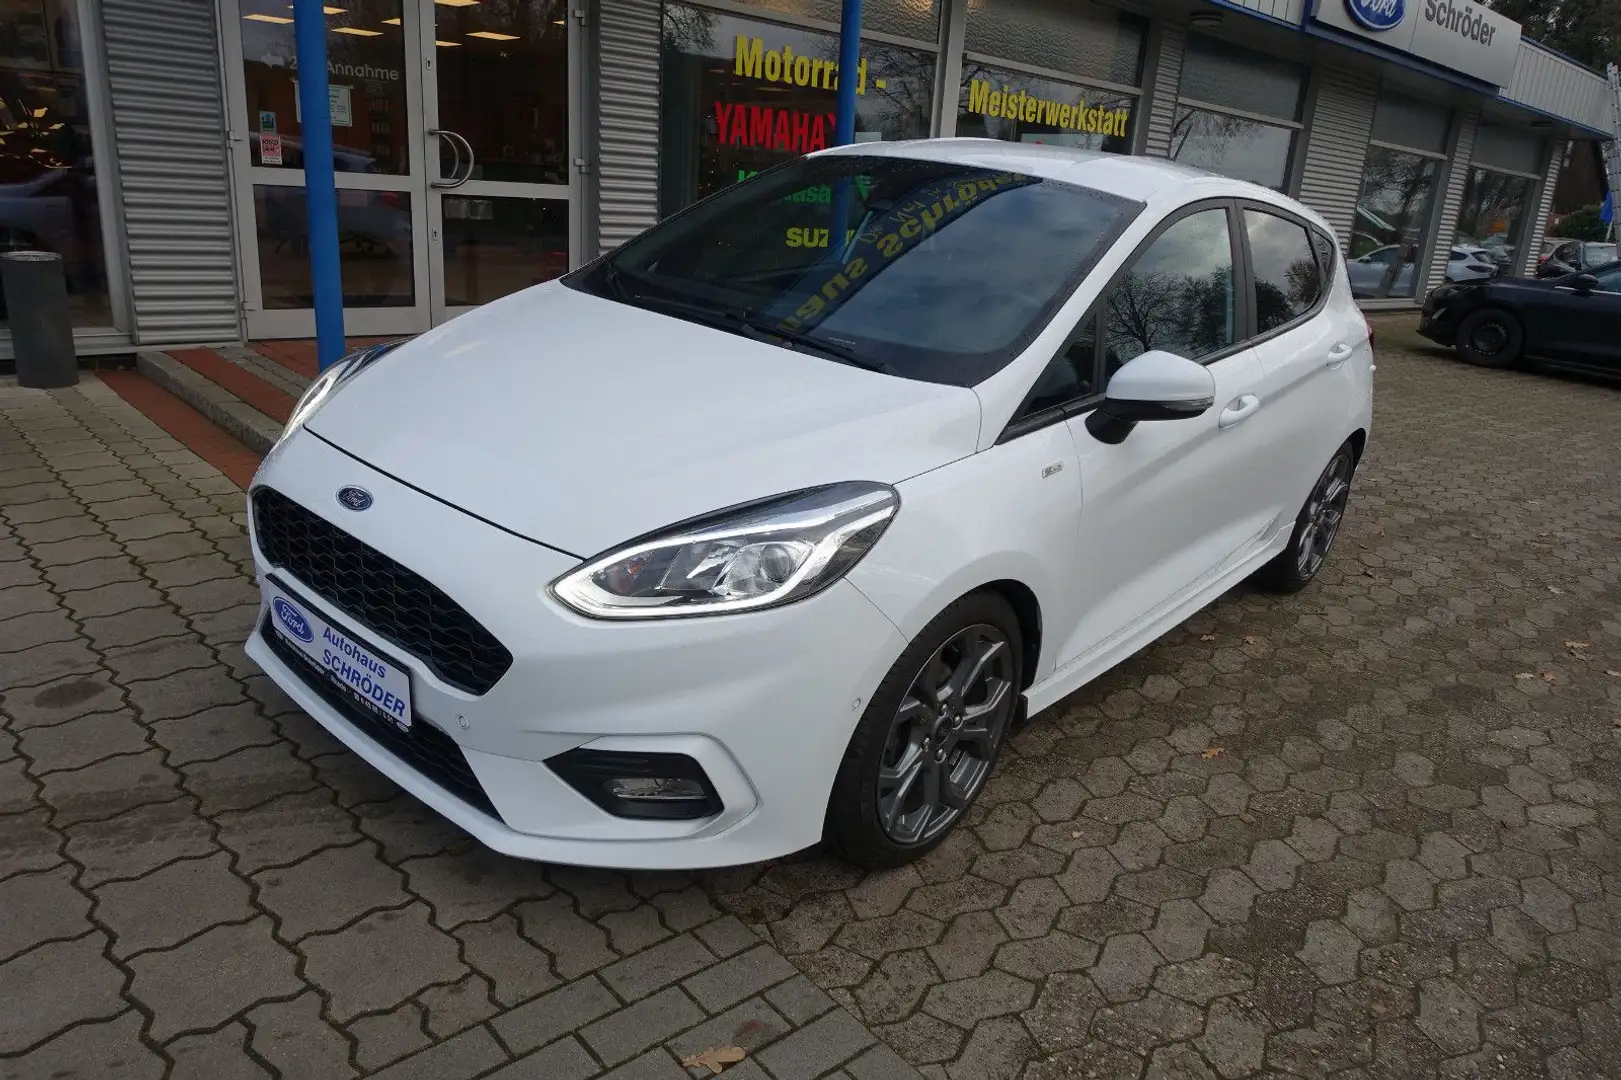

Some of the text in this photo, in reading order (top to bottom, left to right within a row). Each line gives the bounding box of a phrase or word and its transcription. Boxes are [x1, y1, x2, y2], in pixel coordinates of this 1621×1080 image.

[1424, 0, 1496, 46] Schröder
[327, 60, 399, 81] Annahme
[714, 101, 826, 153] YAMAHA
[968, 79, 1128, 137] Meisterwerkstatt
[280, 604, 305, 635] Ford
[323, 627, 386, 678] Autohaus
[323, 649, 406, 718] SCHRÖDER
